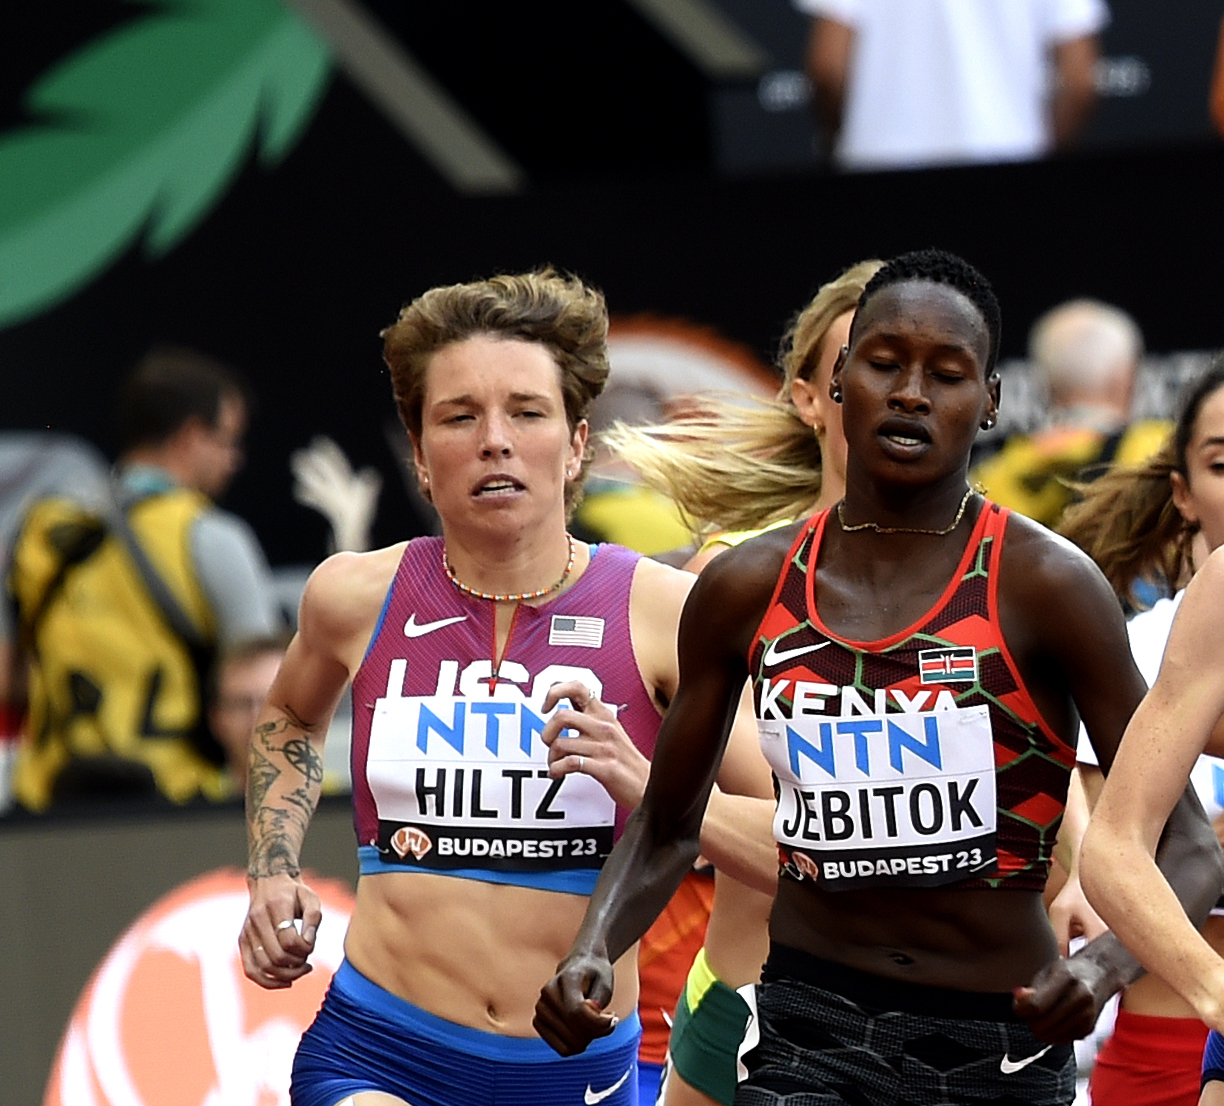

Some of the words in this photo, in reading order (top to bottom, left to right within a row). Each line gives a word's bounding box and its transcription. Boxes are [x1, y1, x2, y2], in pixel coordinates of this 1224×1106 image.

[786, 716, 942, 779] NTN
[415, 768, 566, 820] HILTZ
[782, 778, 984, 841] JEBITOK
[438, 837, 568, 858] BUDAPEST
[571, 838, 597, 856] 23
[823, 854, 953, 879] BUDAPEST
[955, 848, 982, 868] 23
